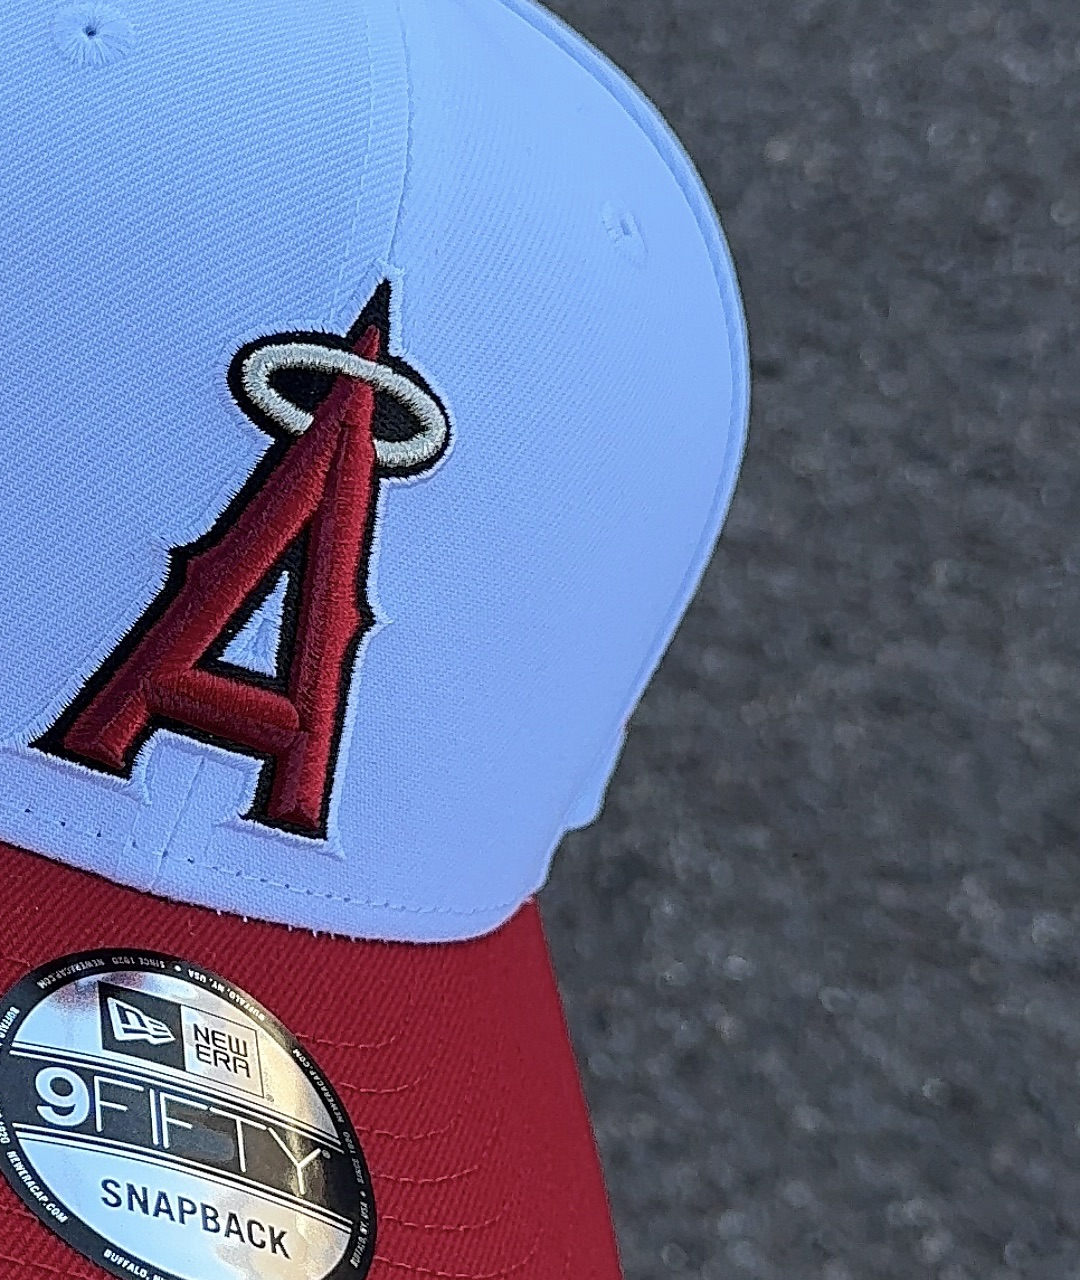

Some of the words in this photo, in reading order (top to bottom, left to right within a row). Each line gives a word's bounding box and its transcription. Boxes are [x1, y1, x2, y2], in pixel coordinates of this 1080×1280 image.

[28, 278, 450, 840] A
[188, 969, 207, 983] USA
[193, 1023, 248, 1058] NEW
[196, 1047, 251, 1078] ERA
[35, 1067, 321, 1196] 9FIFTY
[7, 1150, 68, 1223] NEWERACAP.COM
[101, 1178, 290, 1259] SNAPBACK
[104, 1249, 150, 1280] BUFFALO,
